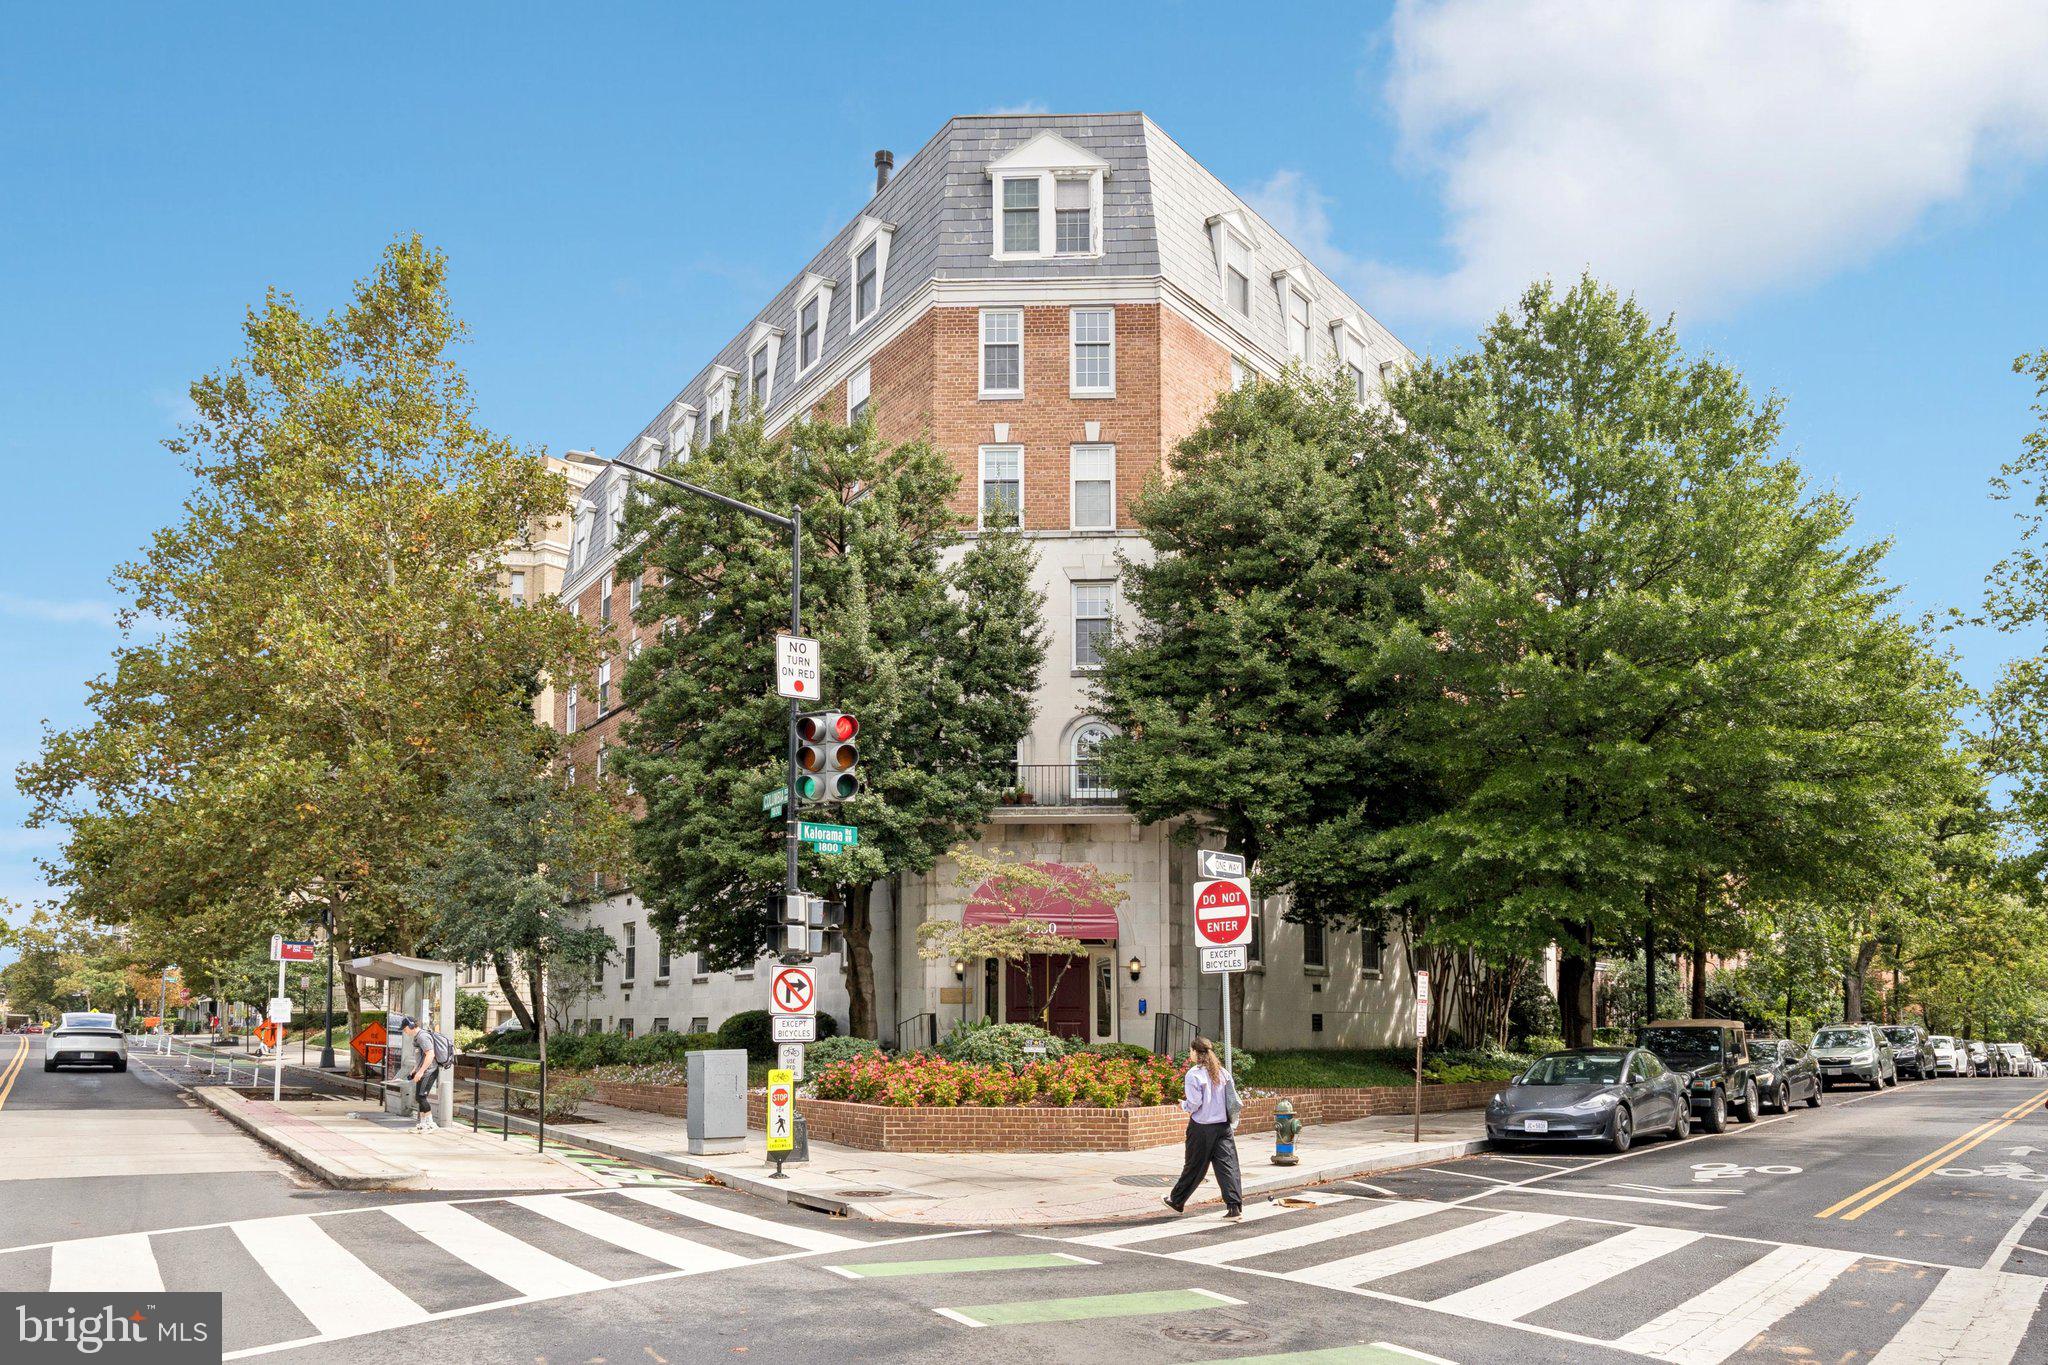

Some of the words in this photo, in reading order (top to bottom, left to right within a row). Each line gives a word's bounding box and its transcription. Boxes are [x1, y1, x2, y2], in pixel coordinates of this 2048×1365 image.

[789, 641, 807, 654] NO
[787, 655, 810, 666] TURN
[781, 666, 794, 676] ON
[798, 668, 815, 679] RED
[804, 825, 843, 842] Kalorama
[818, 842, 839, 852] 1800
[1215, 860, 1227, 872] ONE
[1228, 862, 1241, 873] WAY
[1202, 894, 1217, 905] DO
[1221, 891, 1242, 903] NOT
[1206, 920, 1239, 933] ENTER
[1209, 950, 1237, 959] EXCEPT
[1205, 959, 1242, 969] BICYCLES
[782, 1020, 807, 1028] EXCEPT
[772, 1093, 788, 1102] STOP
